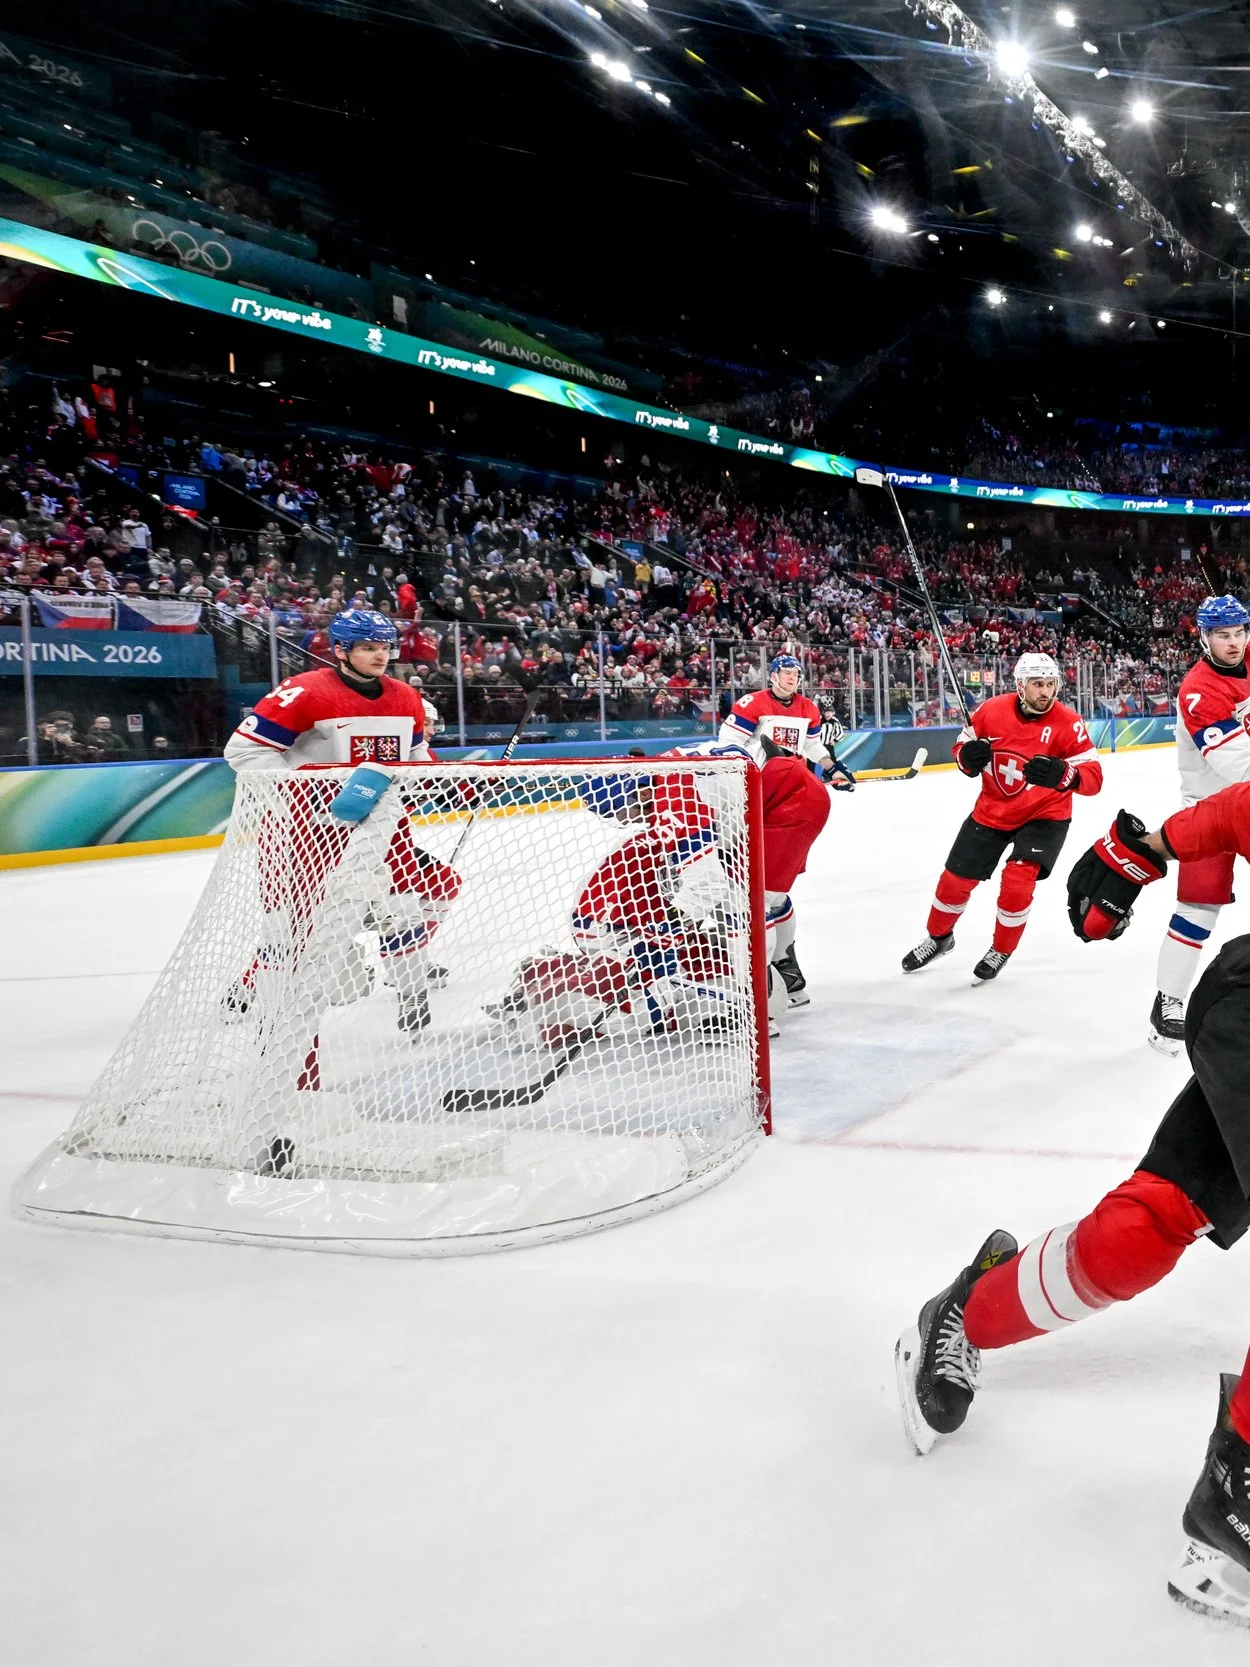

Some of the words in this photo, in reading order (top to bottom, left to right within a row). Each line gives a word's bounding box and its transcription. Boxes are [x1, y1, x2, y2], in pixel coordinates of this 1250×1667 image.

[480, 338, 540, 365] MILANO
[542, 356, 599, 383] CORTINA
[602, 374, 628, 390] 2026
[103, 645, 162, 664] 2026
[1186, 694, 1201, 718] 7
[1040, 726, 1052, 744] A
[1101, 899, 1125, 914] TRUE
